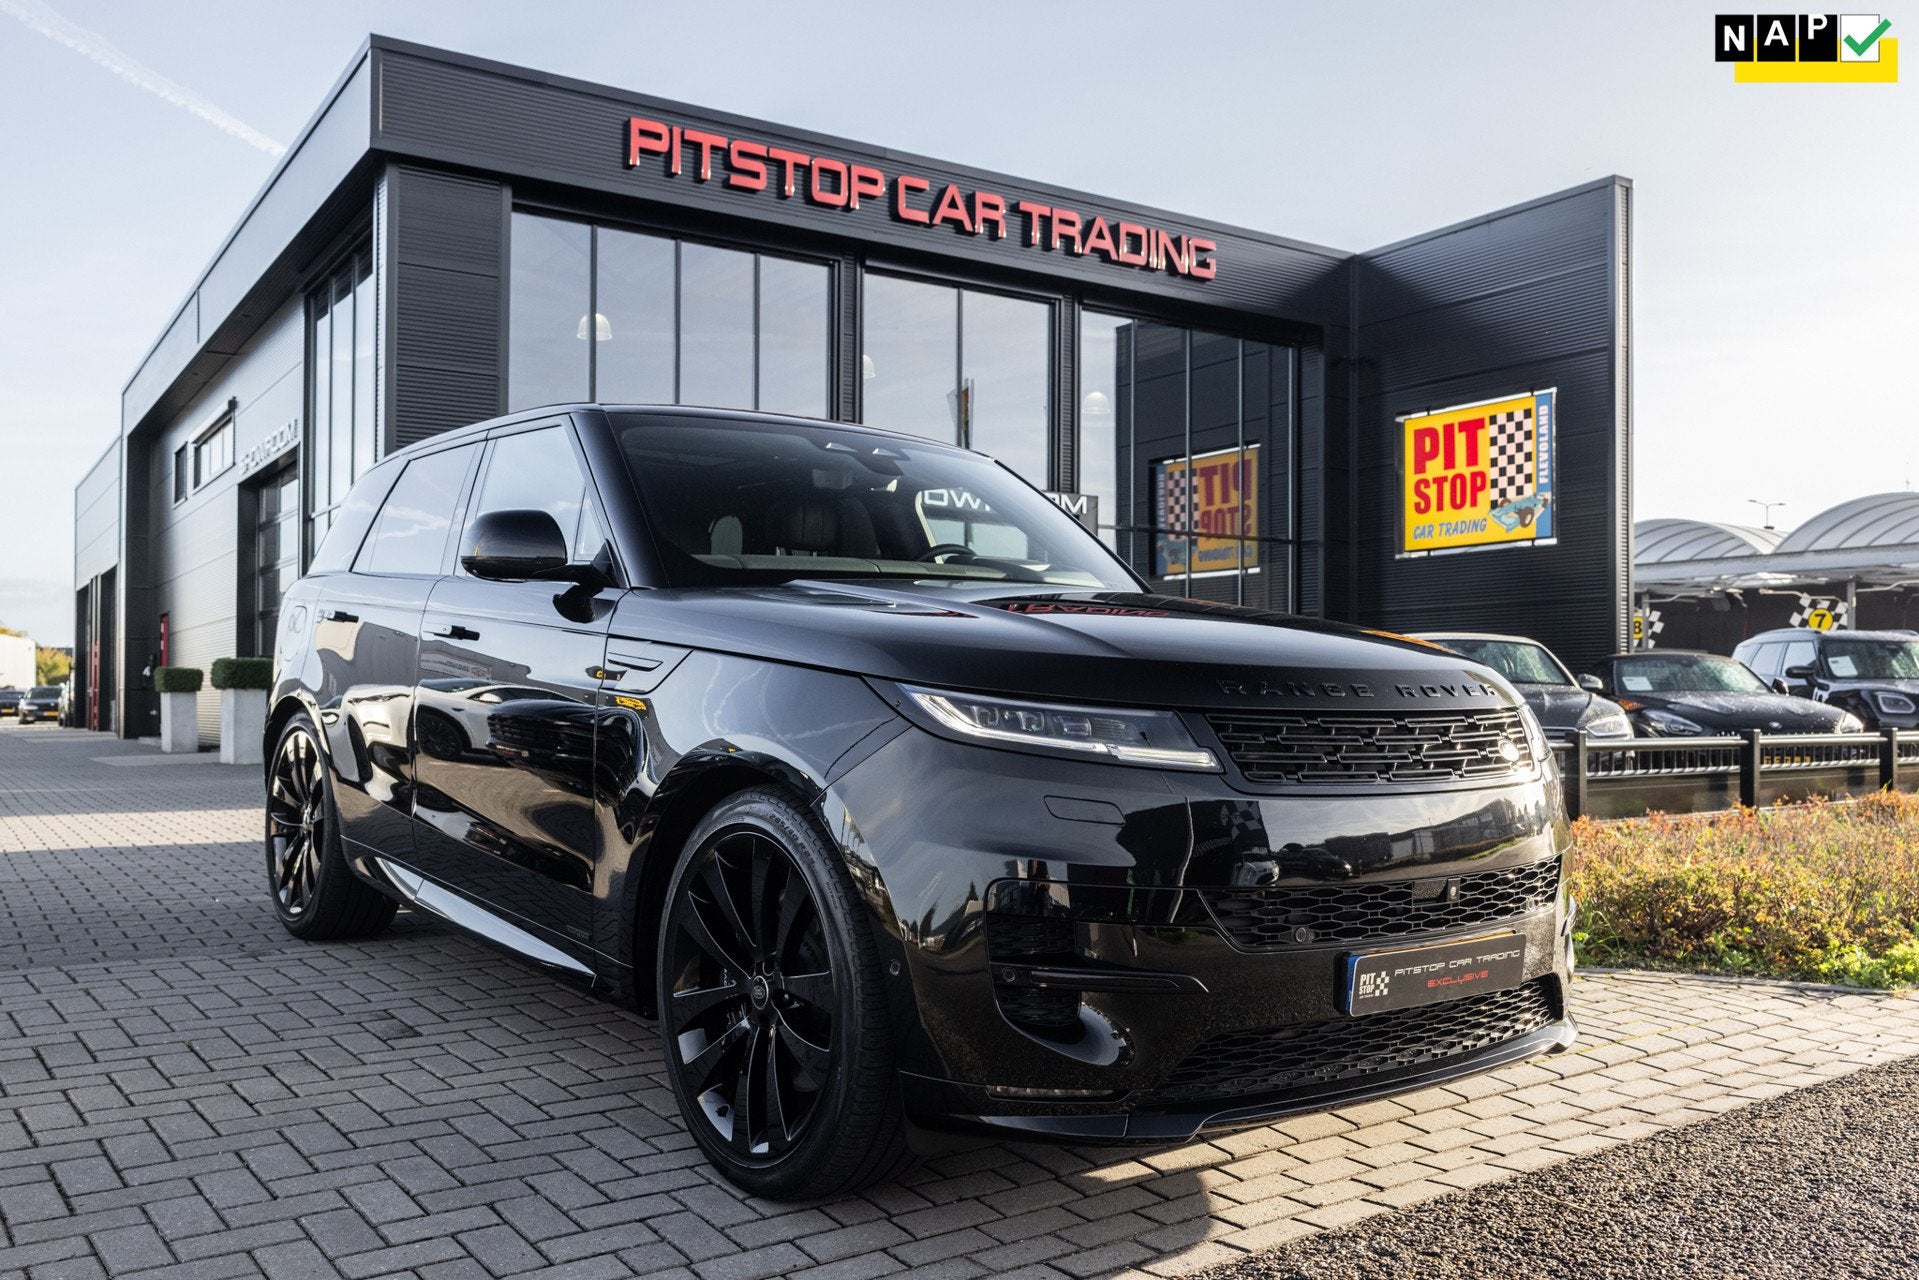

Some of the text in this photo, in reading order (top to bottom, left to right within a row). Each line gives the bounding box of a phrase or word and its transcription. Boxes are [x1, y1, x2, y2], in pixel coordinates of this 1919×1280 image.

[628, 116, 1216, 280] PITSTOP CAR TRADING
[1413, 417, 1485, 475] PIT
[1538, 404, 1549, 484] FLEVOLAND
[1413, 470, 1487, 515] STOP
[1413, 518, 1488, 540] CAR TRADING
[1814, 613, 1826, 628] 7
[1216, 679, 1498, 698] RANGE ROVER
[1394, 949, 1520, 976] PITSTOP CAR TRADING
[1358, 984, 1375, 995] STOP
[1360, 972, 1376, 986] PIT
[1427, 970, 1489, 988] EXCLUSIVE
